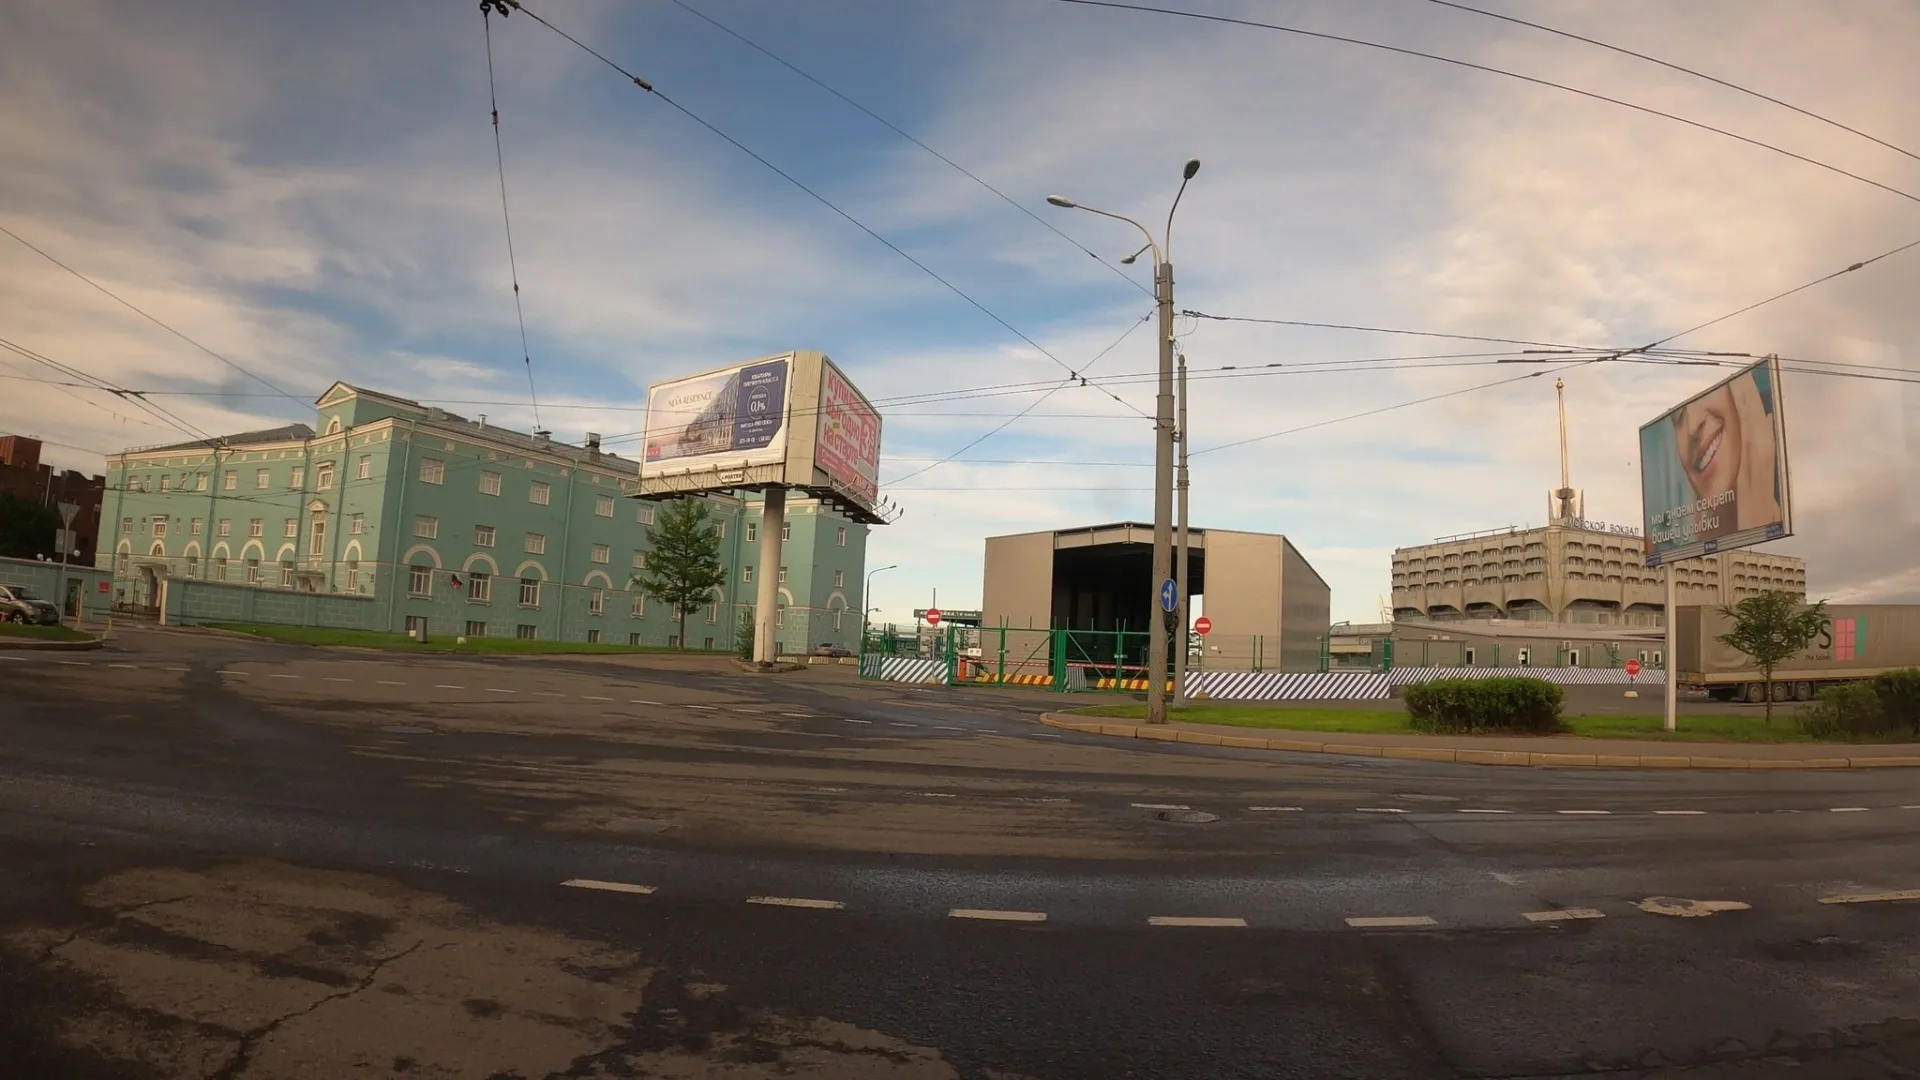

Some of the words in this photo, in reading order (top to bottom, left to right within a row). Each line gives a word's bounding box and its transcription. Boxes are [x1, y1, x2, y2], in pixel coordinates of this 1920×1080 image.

[1696, 489, 1735, 511] секрет
[1609, 523, 1639, 536] ВОКЗАЛ
[1651, 524, 1680, 544] вашей
[1682, 515, 1720, 542] улыбки
